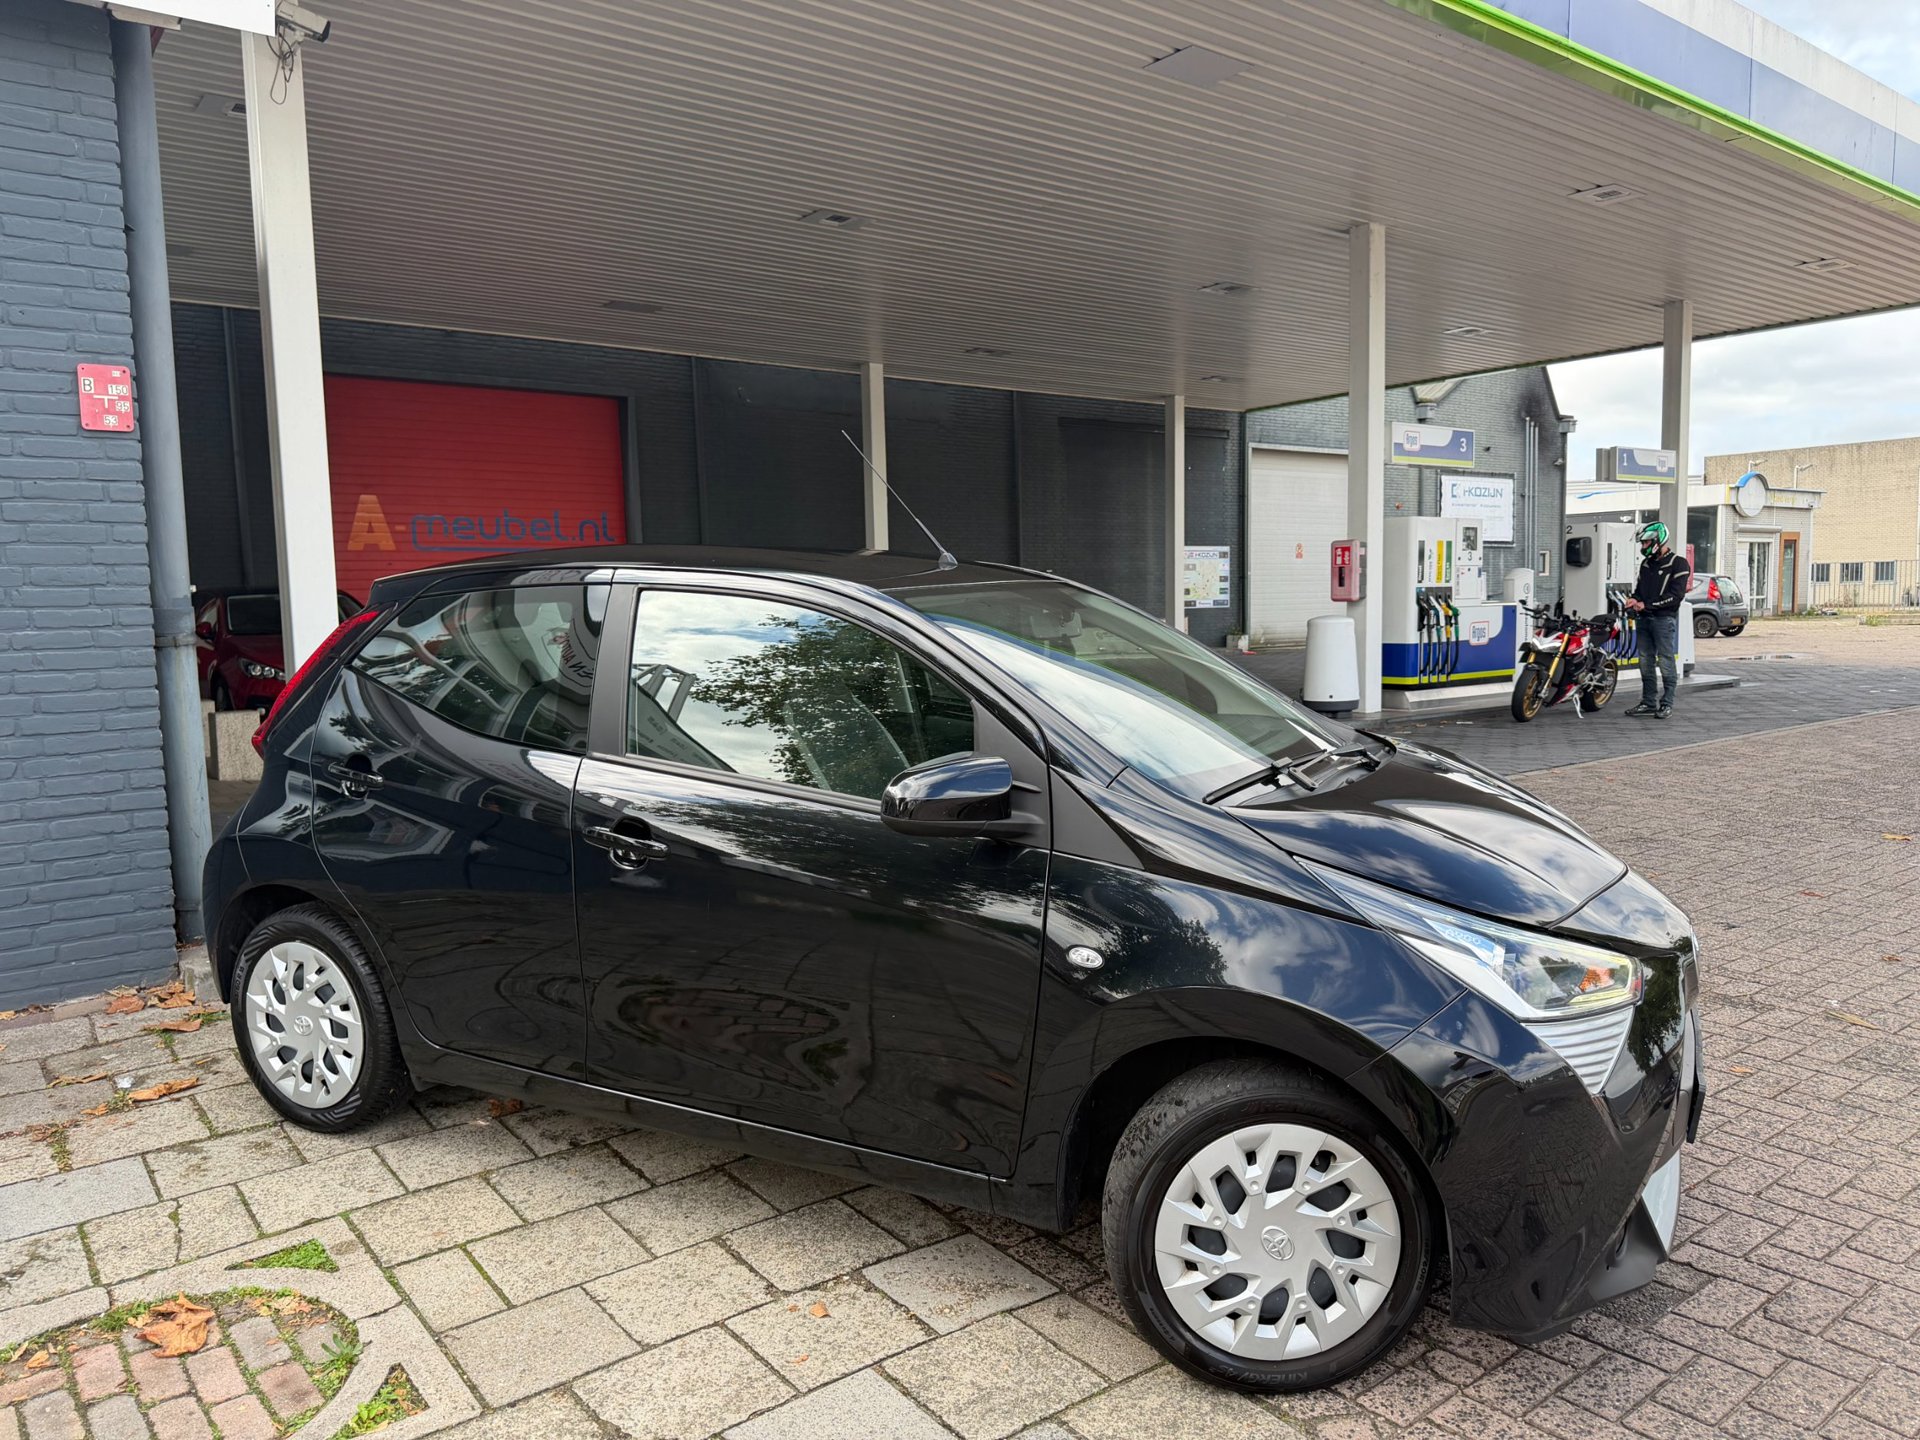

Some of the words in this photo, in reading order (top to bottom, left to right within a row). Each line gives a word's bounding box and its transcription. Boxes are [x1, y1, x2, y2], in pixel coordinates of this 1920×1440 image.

[82, 378, 93, 392] B
[110, 385, 128, 395] 150
[116, 401, 130, 411] 95
[104, 415, 118, 425] 53
[1459, 438, 1467, 452] 3
[1623, 453, 1628, 466] 1
[1566, 525, 1573, 535] 2
[1593, 524, 1598, 533] 1
[1467, 551, 1473, 561] 3
